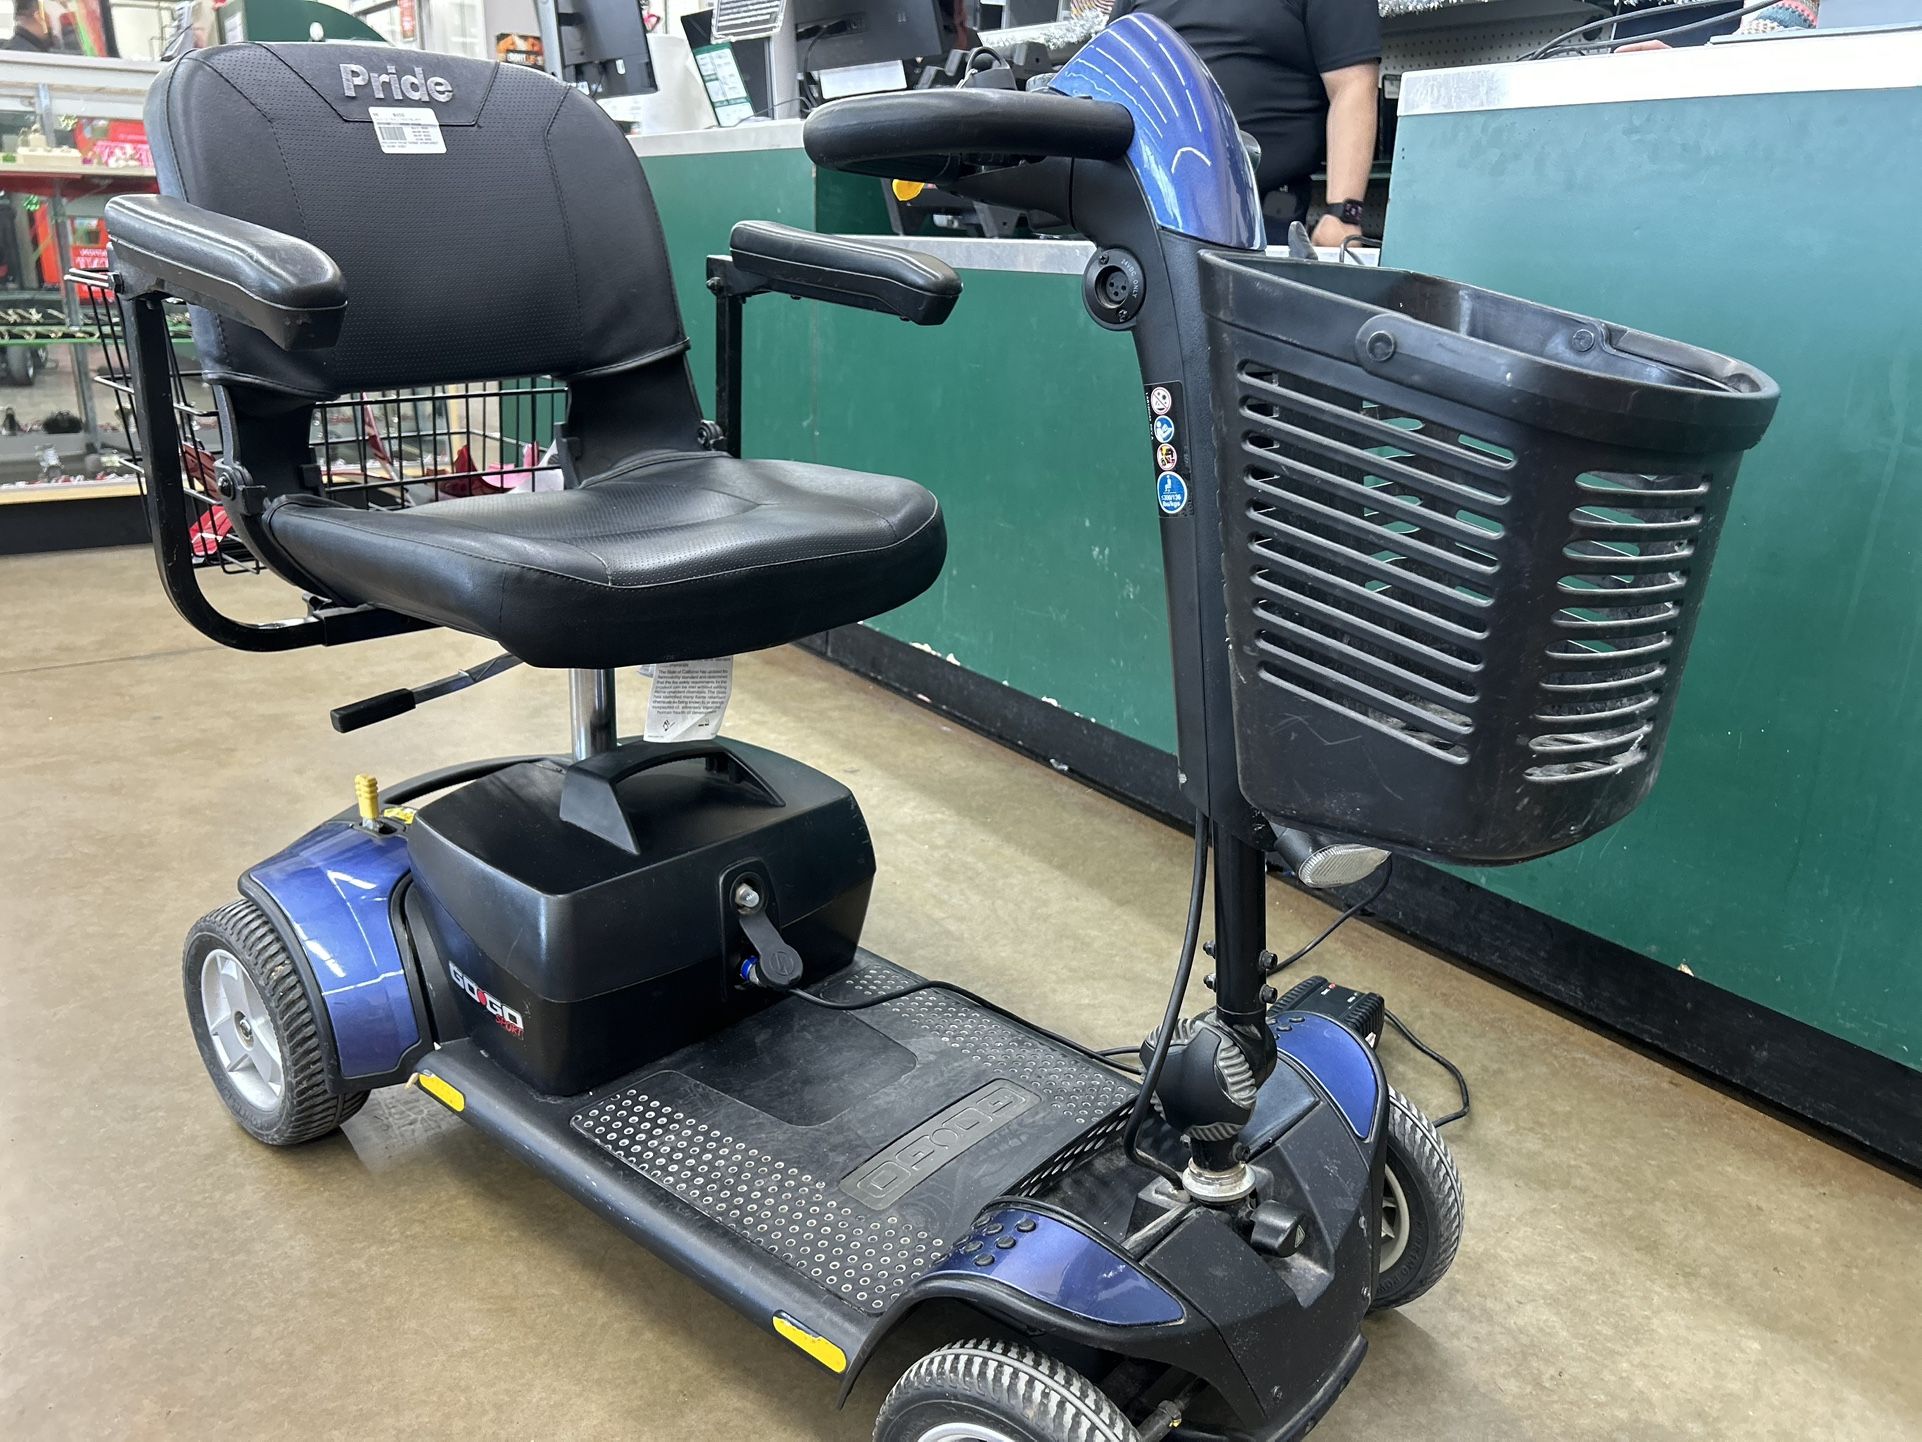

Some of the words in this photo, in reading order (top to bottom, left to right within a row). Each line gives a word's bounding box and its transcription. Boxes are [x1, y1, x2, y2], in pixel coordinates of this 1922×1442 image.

[339, 63, 454, 103] Pride
[1120, 258, 1137, 277] 24VDC
[496, 1014, 524, 1037] SPORT
